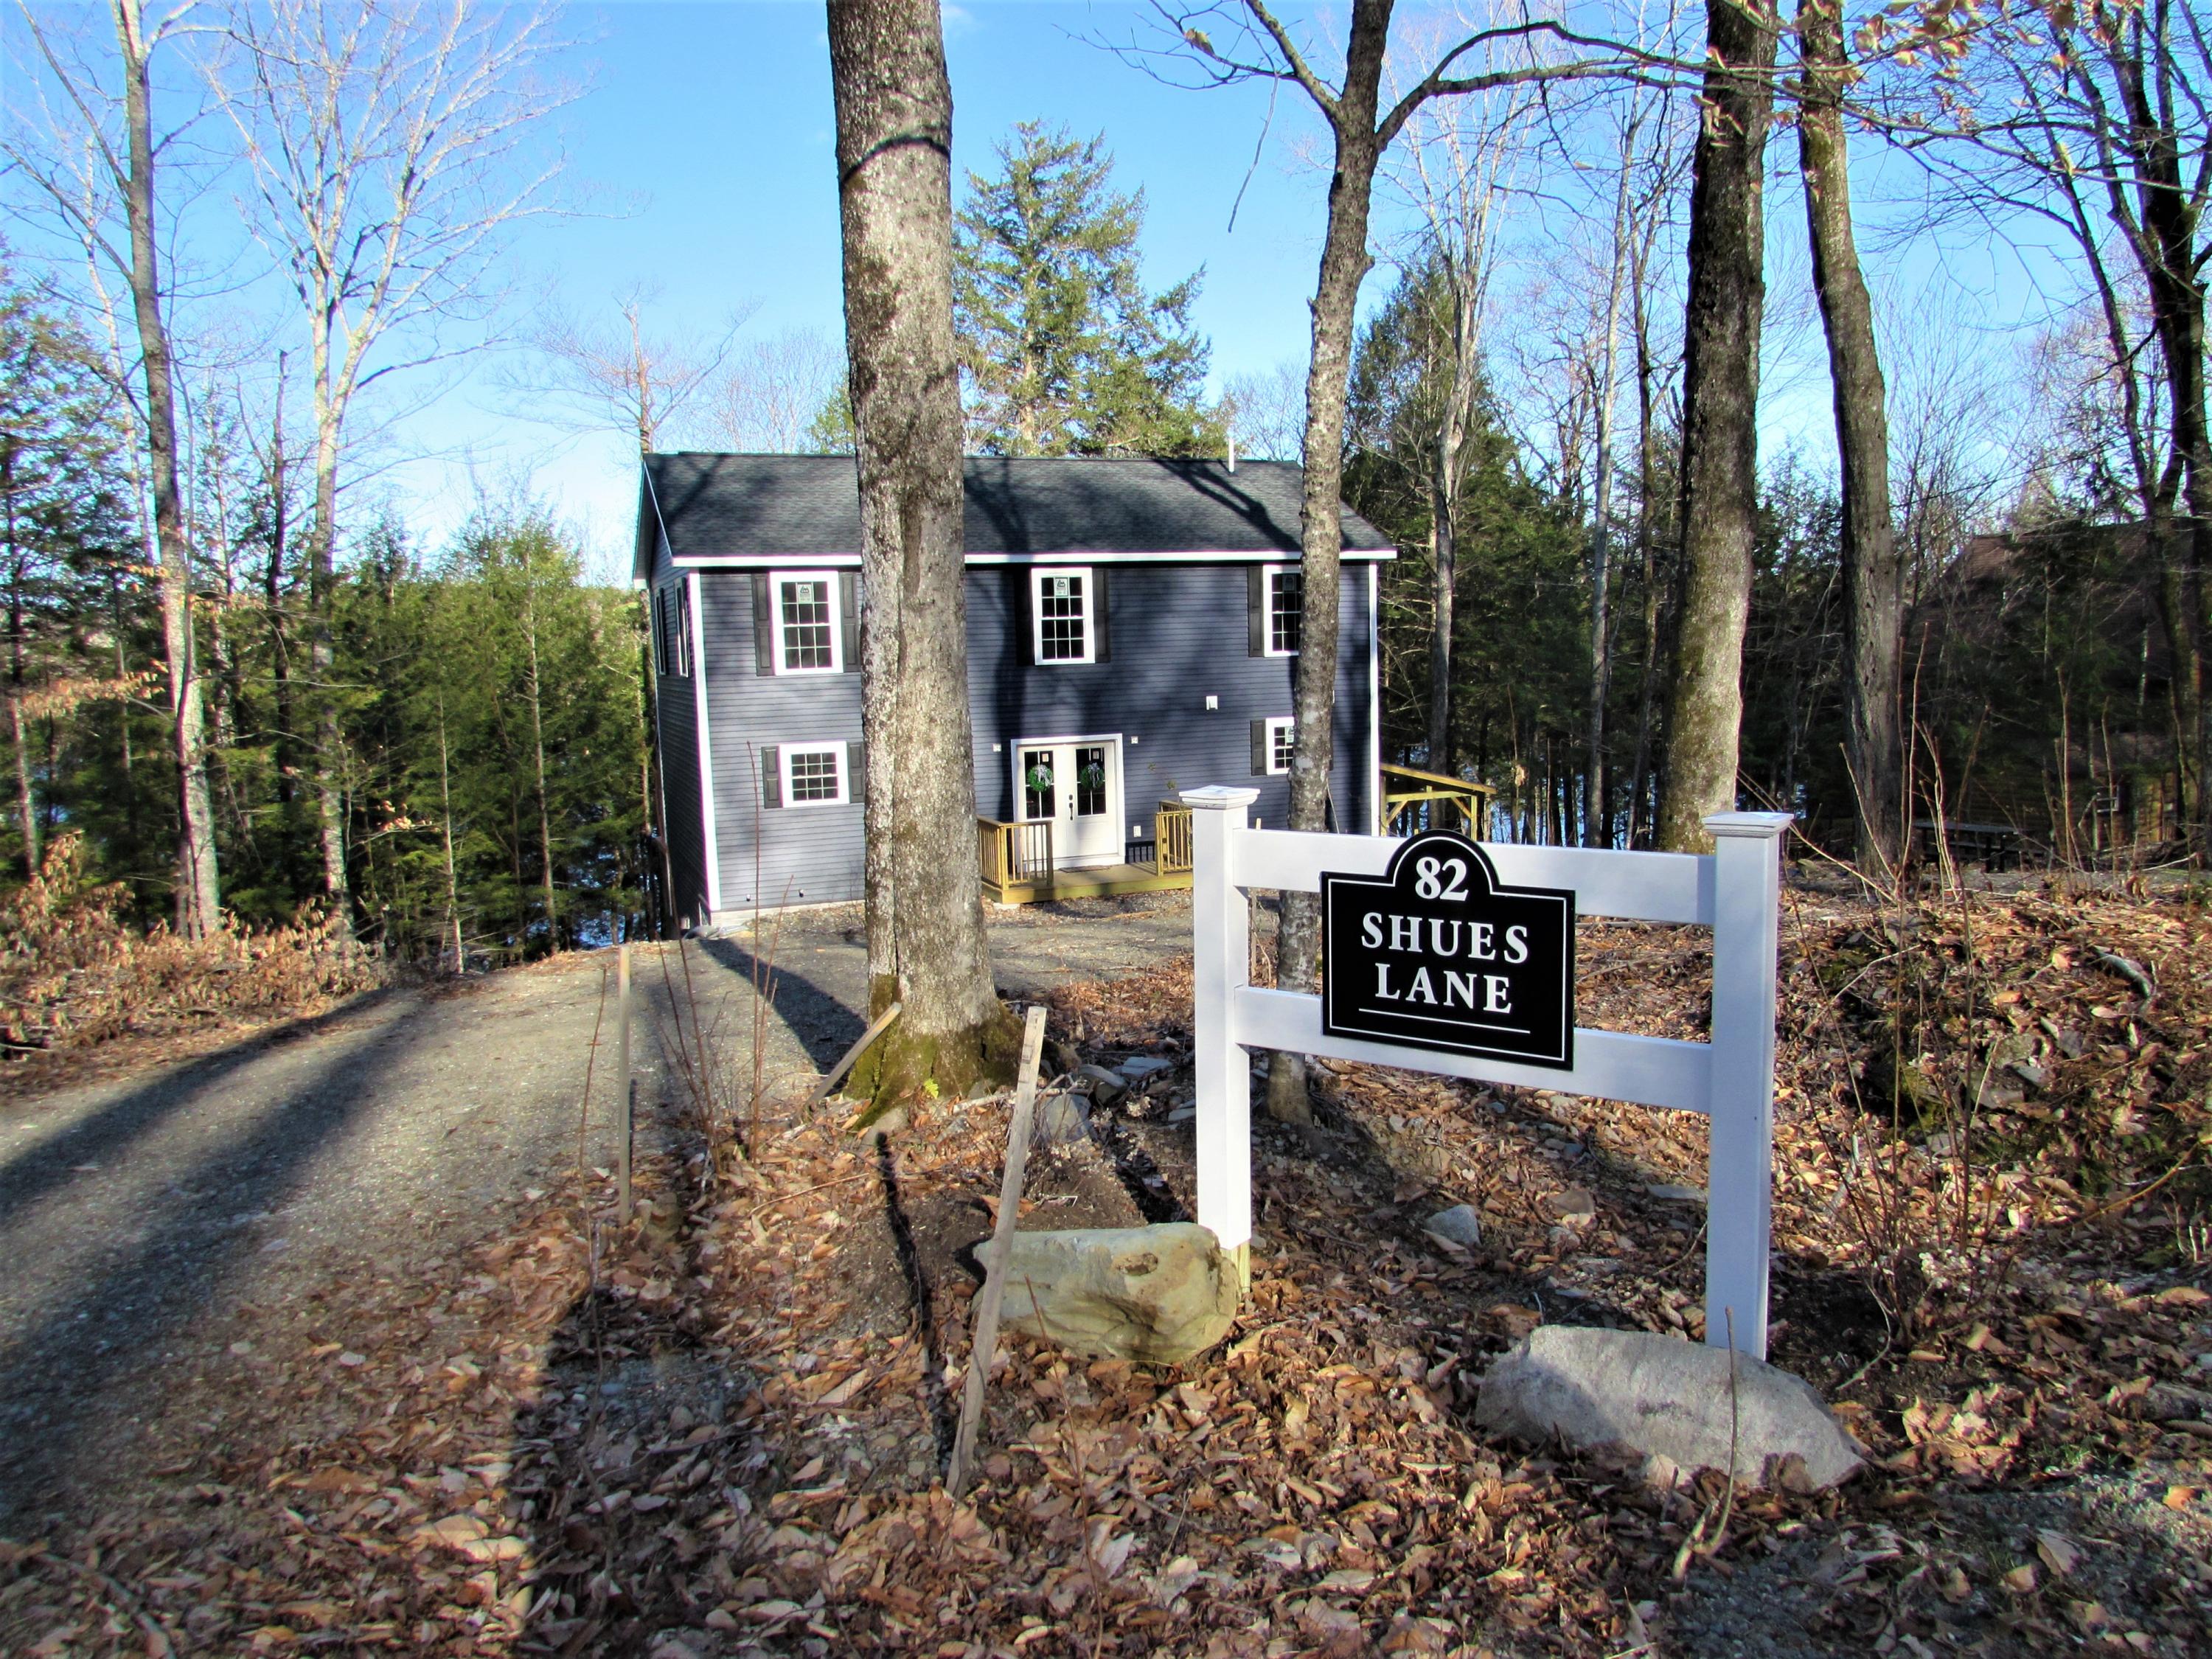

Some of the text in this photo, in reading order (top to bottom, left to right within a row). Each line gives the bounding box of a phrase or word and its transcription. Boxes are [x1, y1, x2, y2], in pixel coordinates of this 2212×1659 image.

[1415, 856, 1469, 902] 82
[1361, 912, 1528, 964] SHUES
[1375, 963, 1512, 1014] LANE
